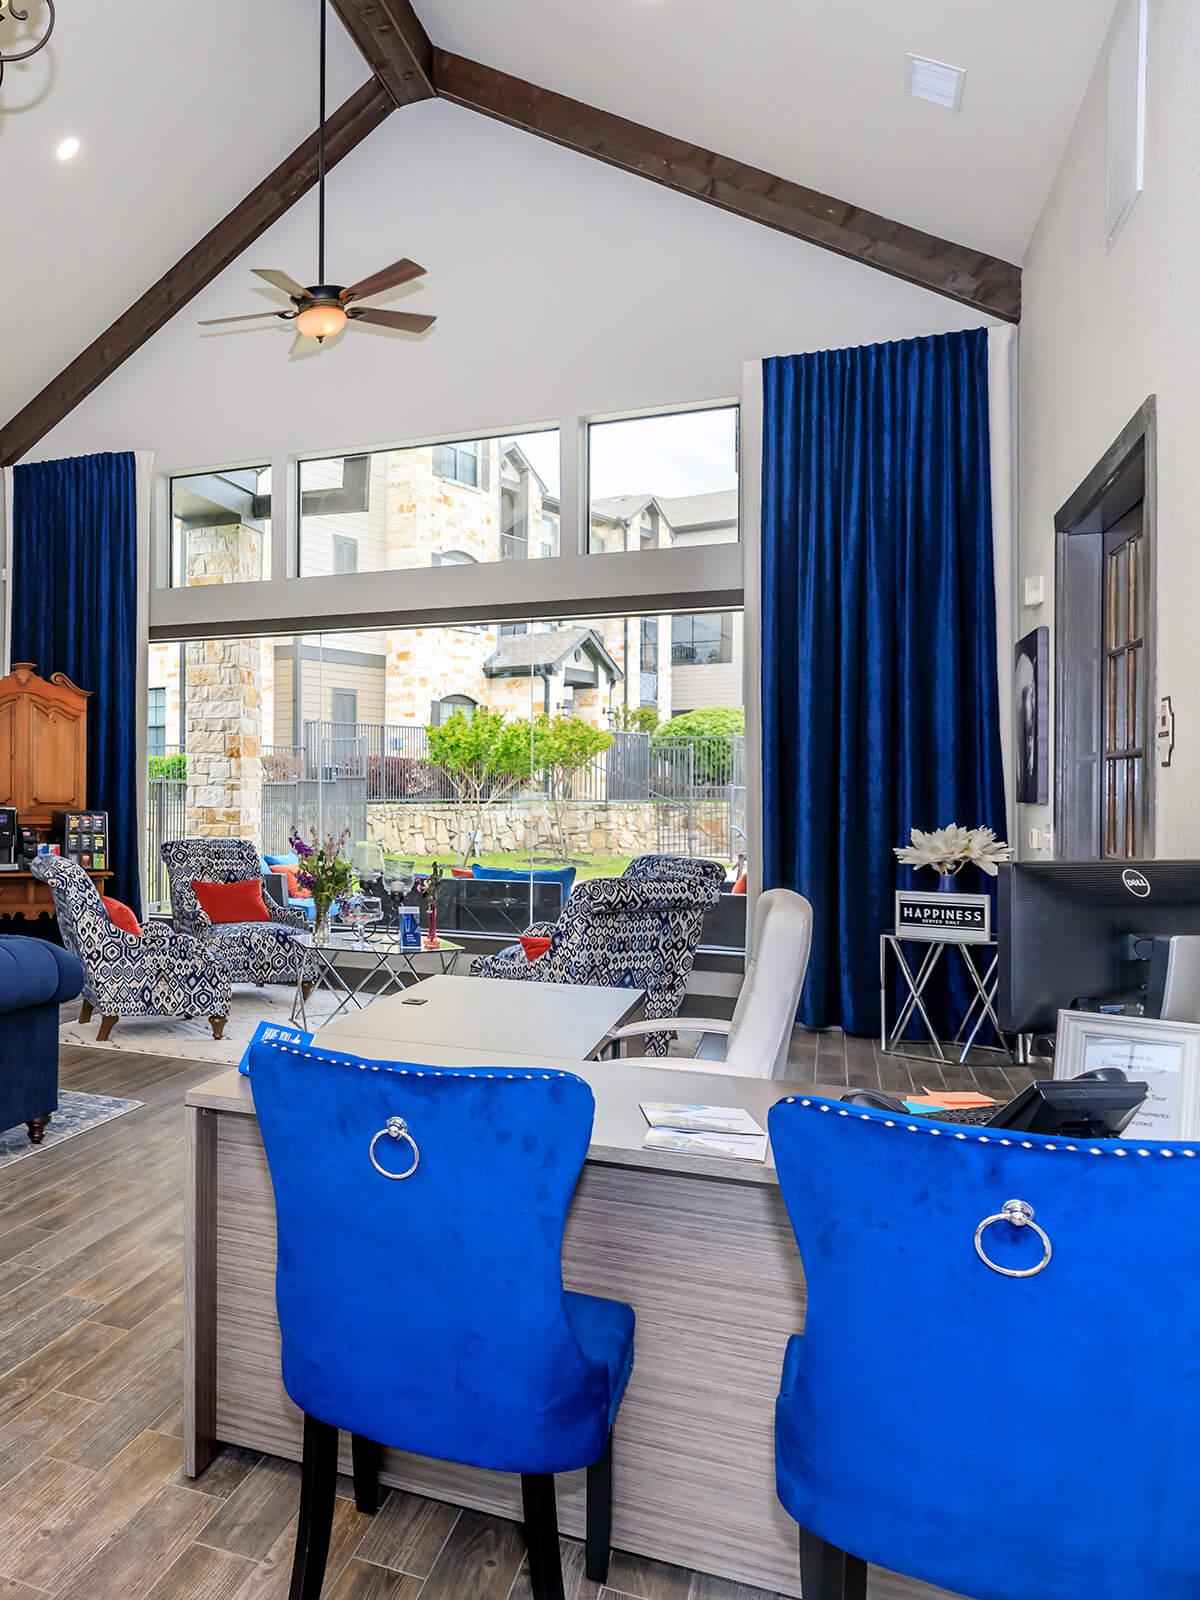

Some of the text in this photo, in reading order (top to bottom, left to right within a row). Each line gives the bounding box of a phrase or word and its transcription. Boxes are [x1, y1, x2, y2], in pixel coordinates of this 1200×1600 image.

[1126, 879, 1147, 887] DELL
[903, 907, 982, 921] HAPPINESS
[1138, 1111, 1170, 1119] ayments
